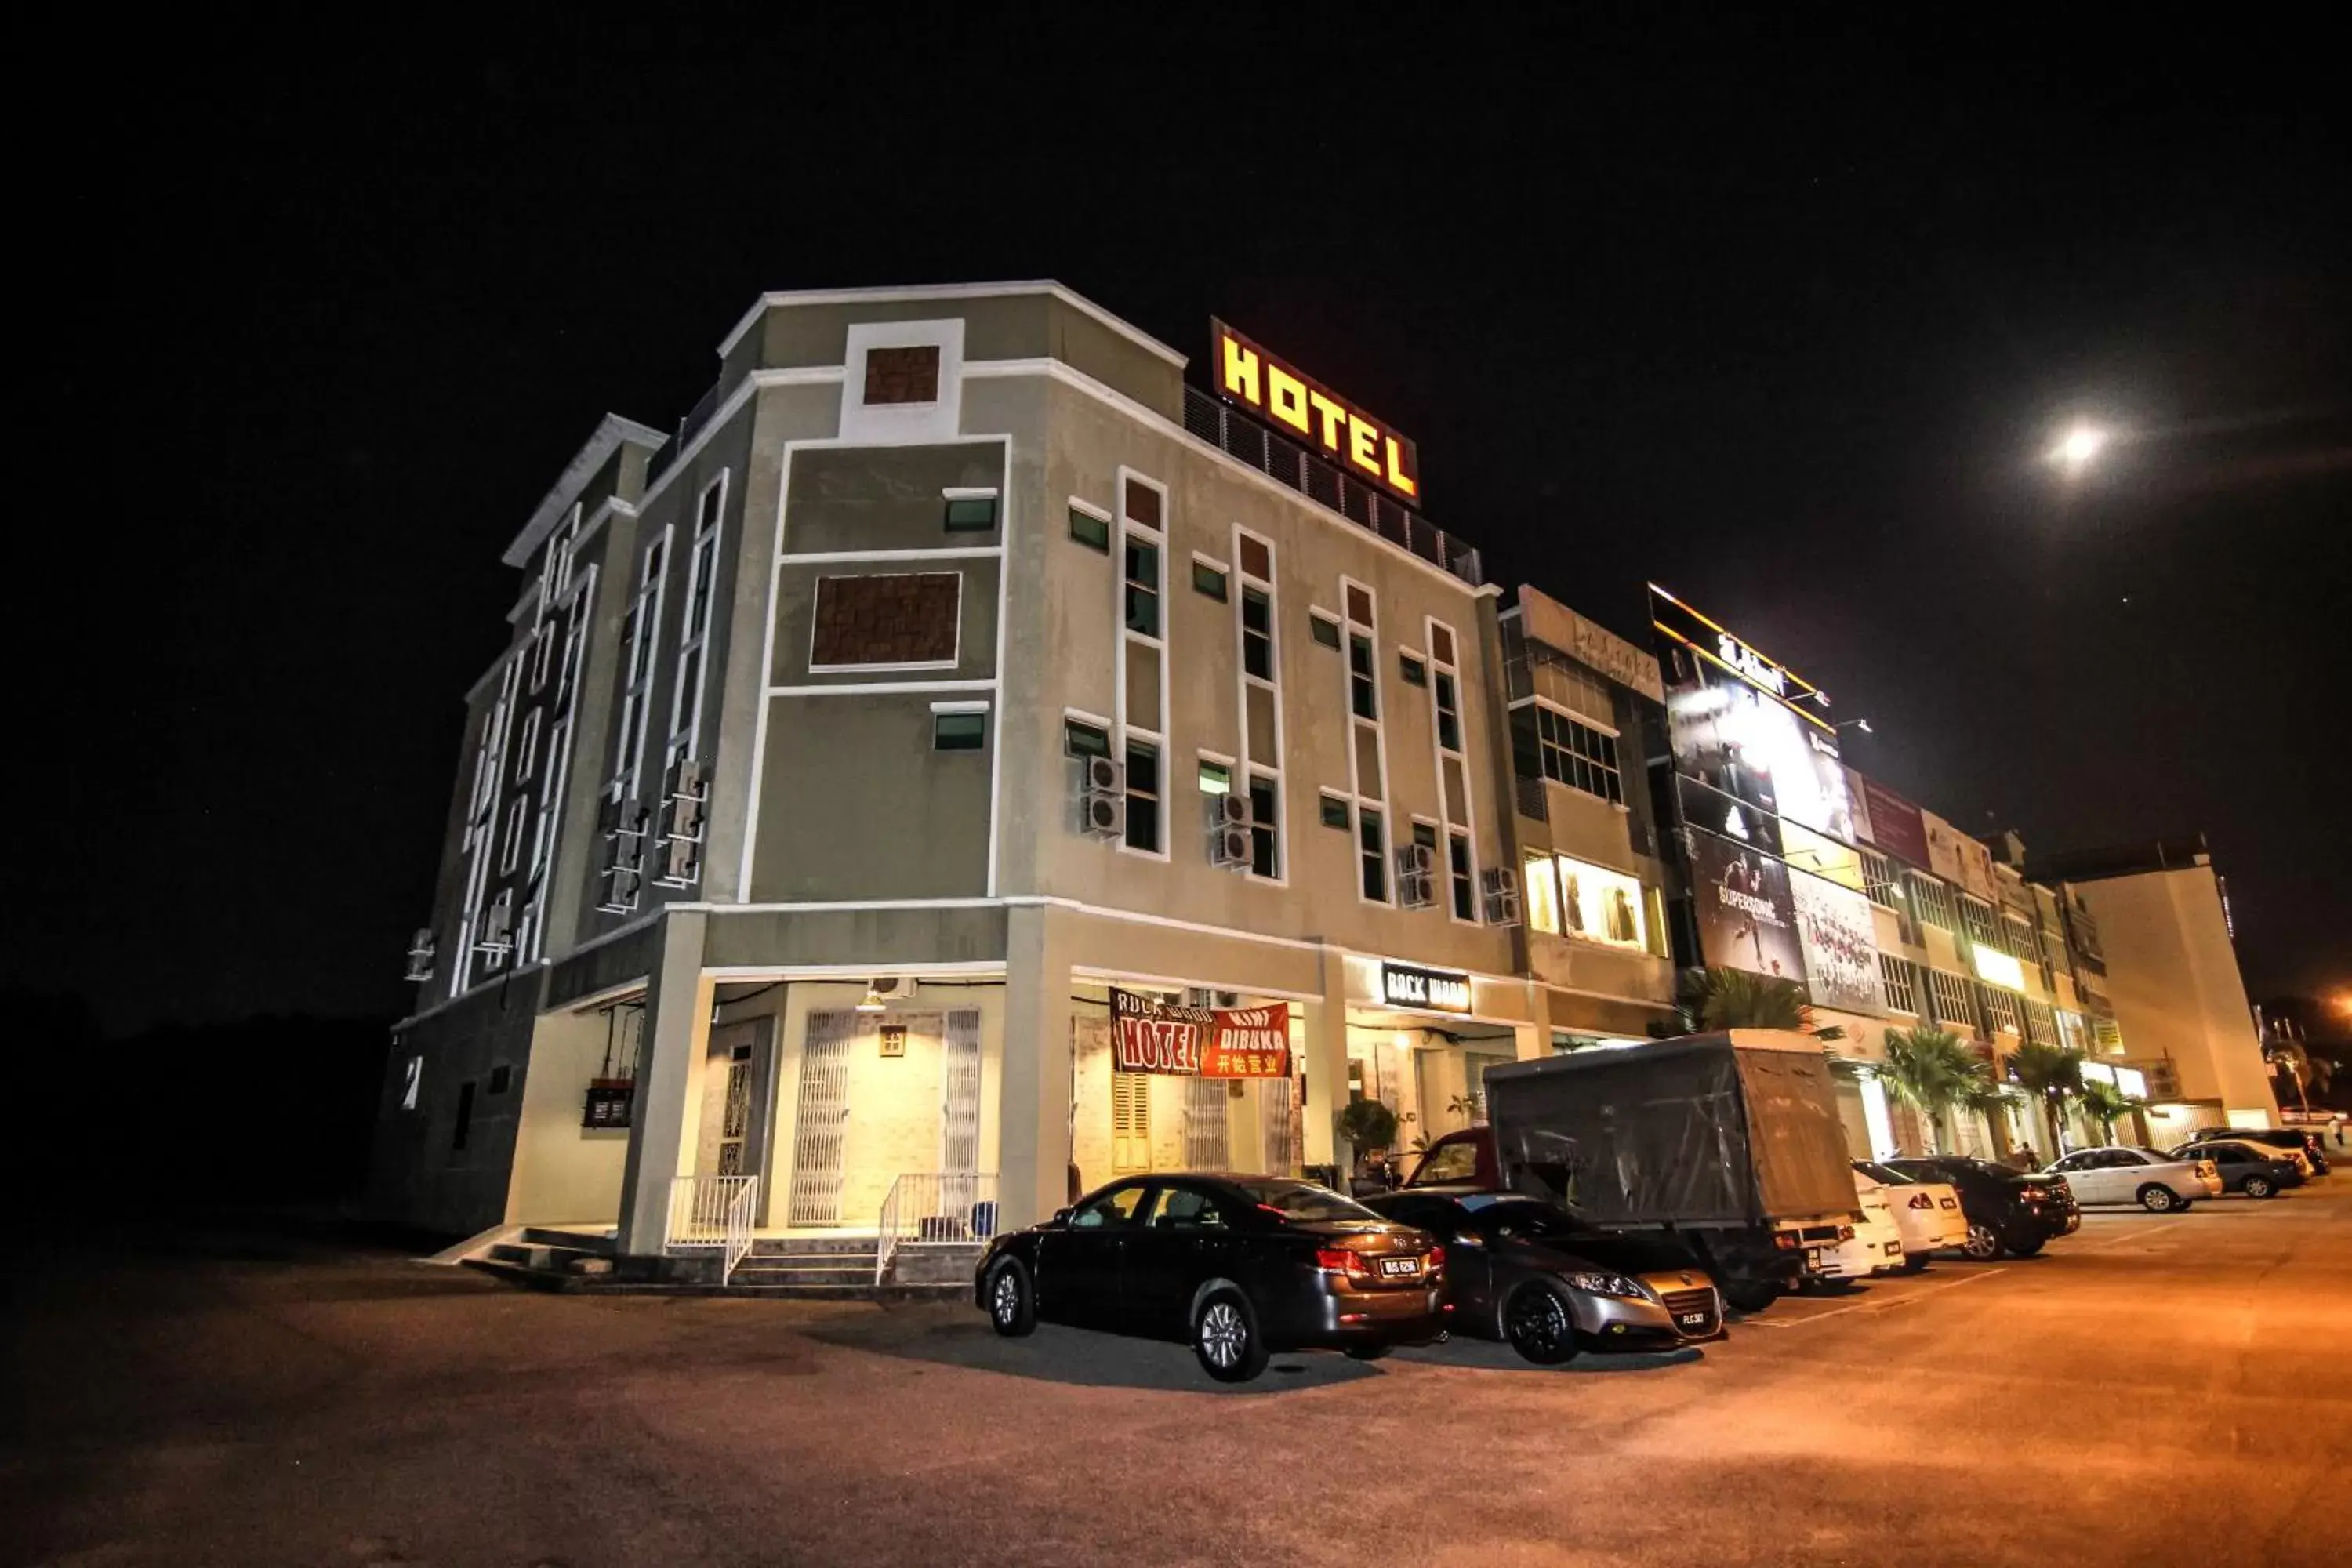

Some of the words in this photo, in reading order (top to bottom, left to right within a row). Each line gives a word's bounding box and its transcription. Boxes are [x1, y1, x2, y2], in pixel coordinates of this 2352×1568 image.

[1223, 335, 1417, 497] HOTEL
[1388, 972, 1426, 1001] ROCK
[1229, 1010, 1270, 1027] KINI
[1120, 1016, 1198, 1071] HOTEL
[1220, 1028, 1285, 1051] DIBUKA
[1216, 1053, 1278, 1073] 开始营业
